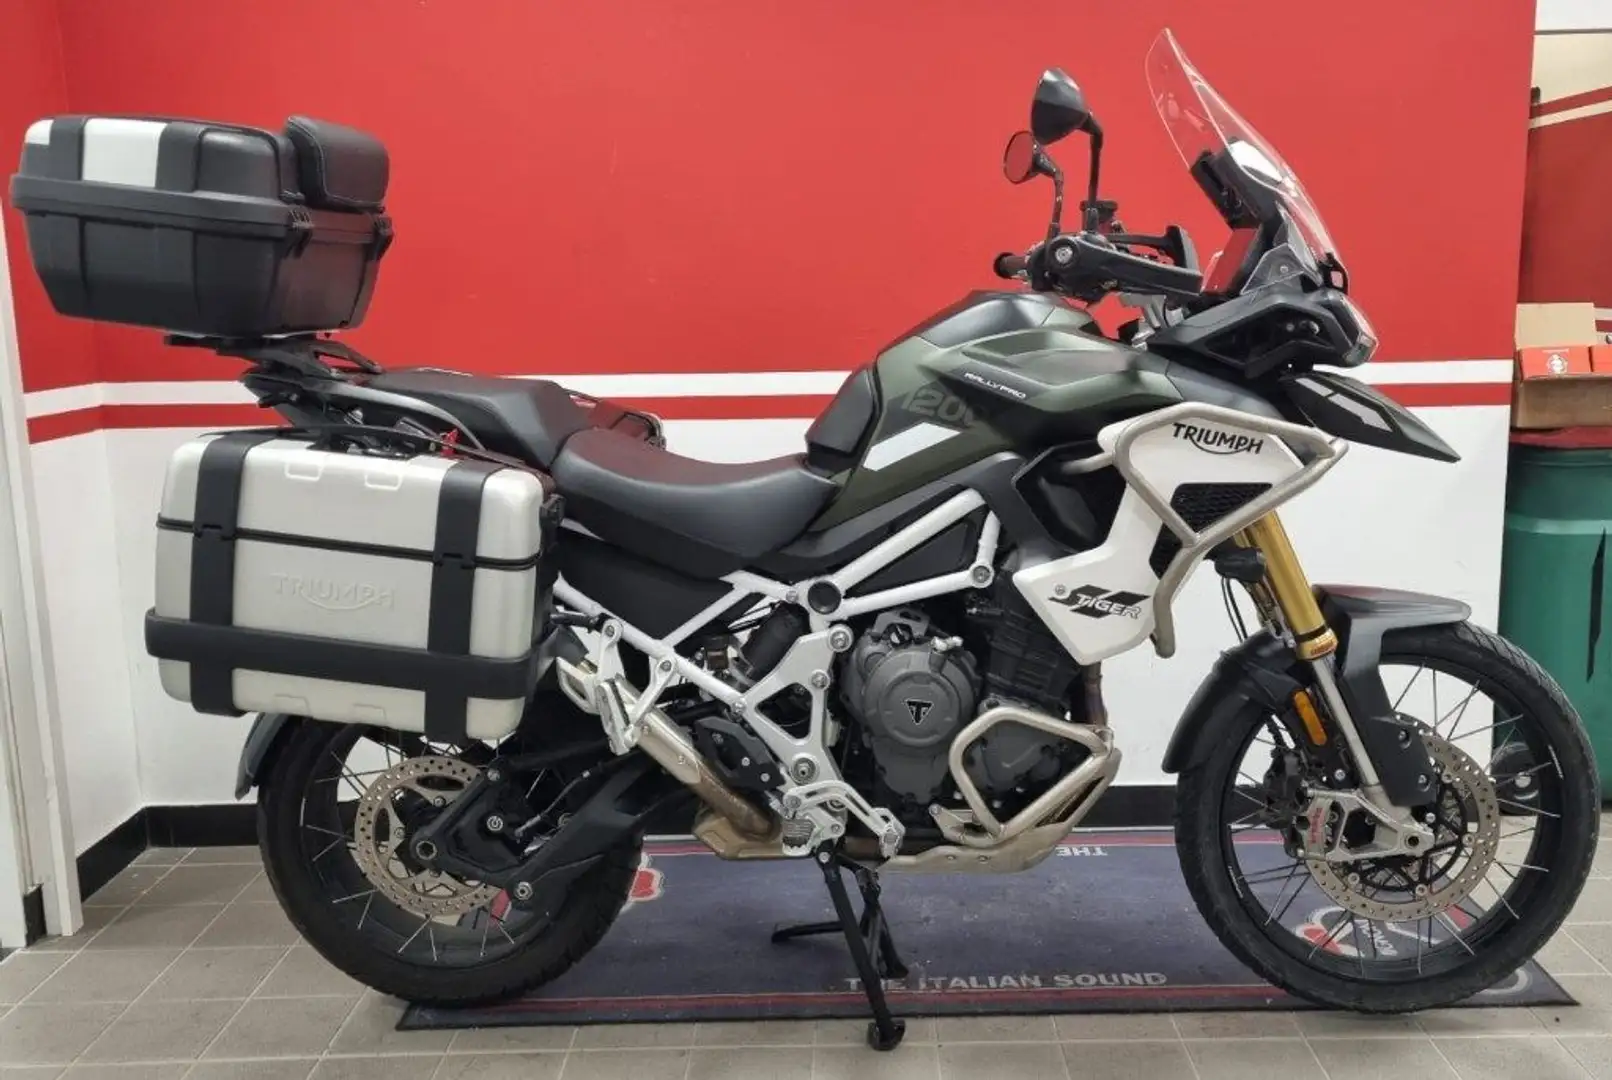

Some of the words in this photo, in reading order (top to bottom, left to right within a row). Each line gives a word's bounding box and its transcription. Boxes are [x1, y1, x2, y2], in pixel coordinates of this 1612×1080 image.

[1172, 421, 1264, 455] TRIUMPH
[269, 571, 396, 612] TRIUMPH
[1076, 593, 1142, 620] TIGER
[1055, 846, 1109, 857] THE
[919, 973, 1042, 990] ITALIAN
[1053, 971, 1168, 987] SOUND
